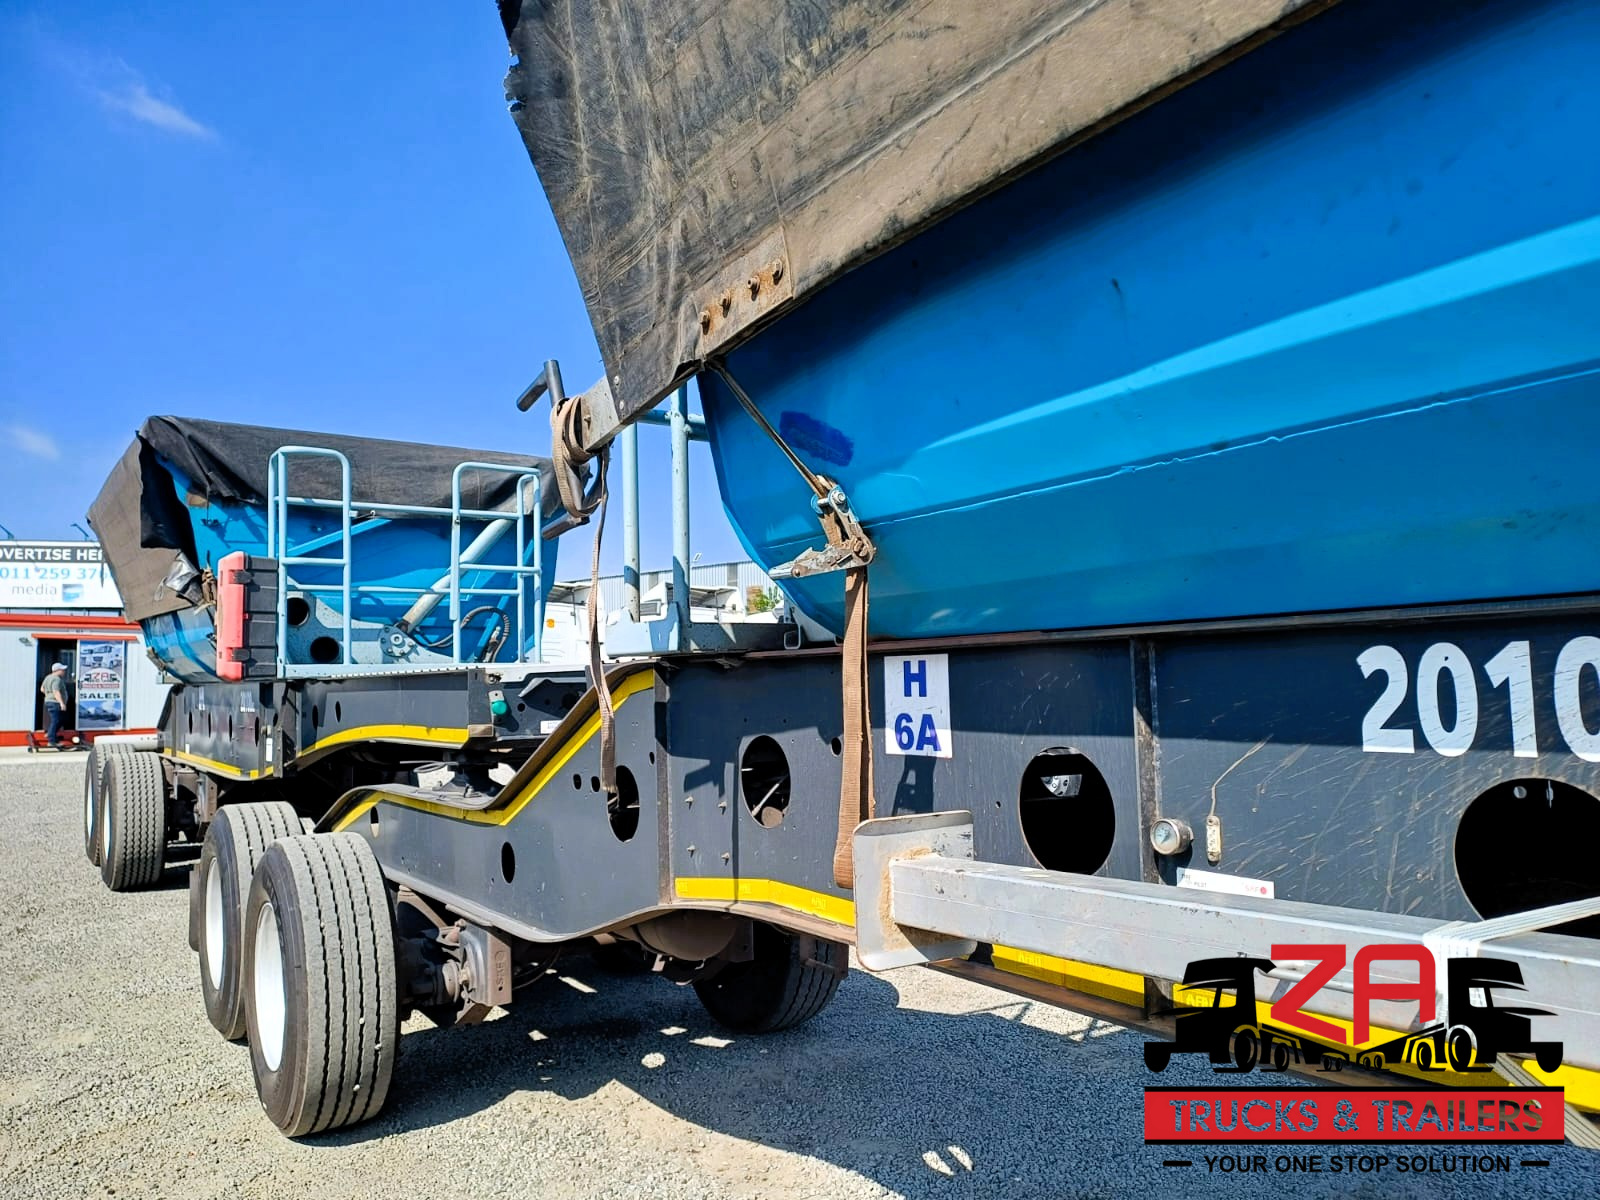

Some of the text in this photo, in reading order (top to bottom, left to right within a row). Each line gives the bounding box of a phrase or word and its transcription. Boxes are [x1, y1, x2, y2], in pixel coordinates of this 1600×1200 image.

[0, 567, 30, 580] 011
[39, 567, 71, 580] 259
[11, 584, 57, 595] media
[903, 660, 927, 697] H
[895, 713, 942, 751] 6A
